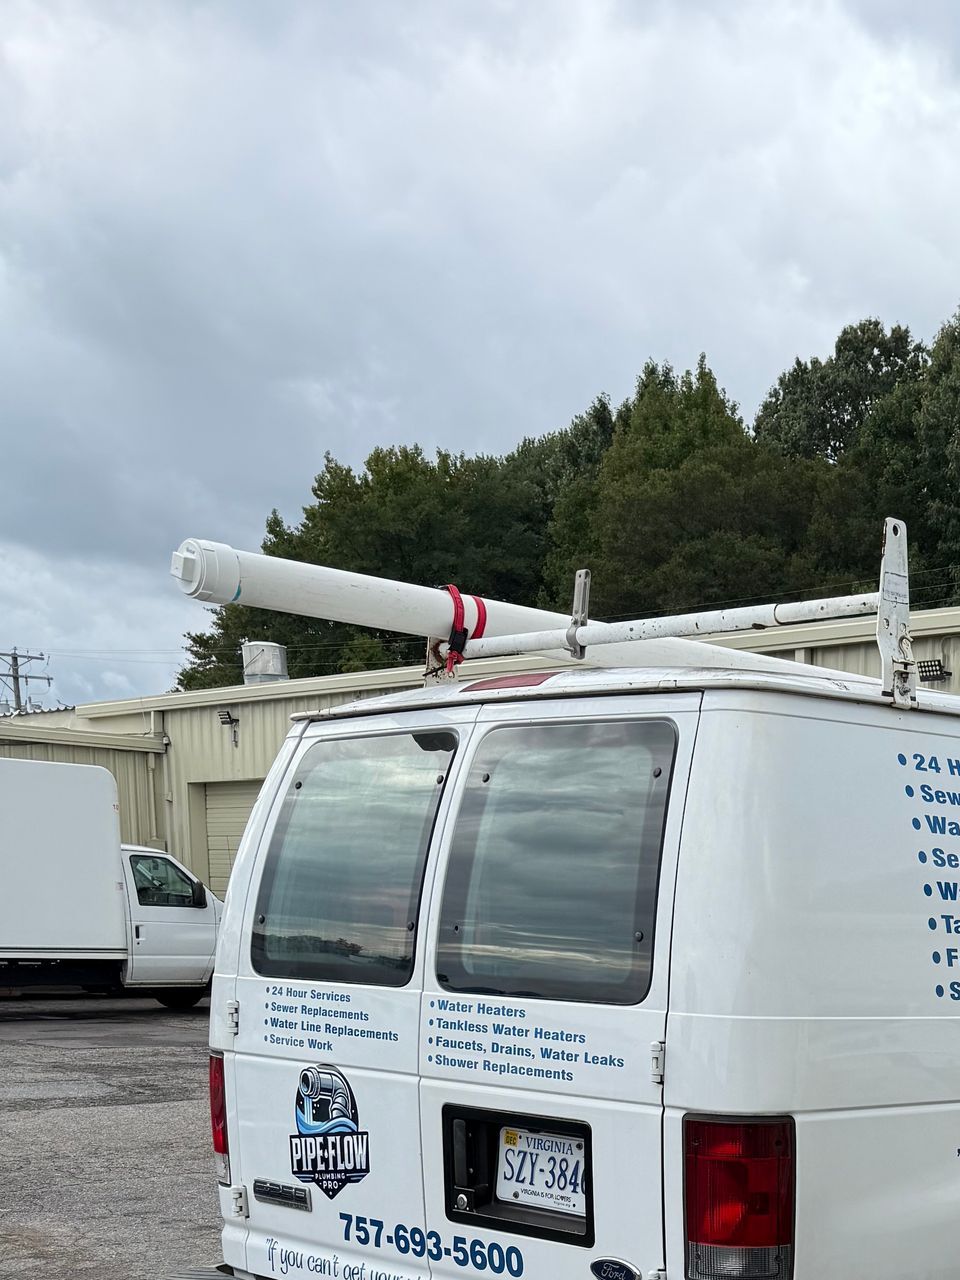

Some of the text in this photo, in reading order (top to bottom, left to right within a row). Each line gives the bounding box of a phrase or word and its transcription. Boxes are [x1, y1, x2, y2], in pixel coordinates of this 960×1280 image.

[913, 753, 941, 774] 24
[272, 986, 351, 1002] 24 Hour Services
[271, 1002, 369, 1021] Sewer Replacements
[437, 1000, 526, 1018] Water Heaters
[270, 1018, 399, 1042] Water Line Replacements
[436, 1018, 586, 1044] Tankless Water Heaters
[270, 1034, 333, 1052] Service Work
[436, 1036, 625, 1068] Faucets, Drains, Water Leaks
[434, 1054, 574, 1082] Shower Replacements
[526, 1136, 574, 1155] VIRGINIA
[314, 1172, 346, 1180] PLUMBING
[339, 1212, 524, 1278] 757-693-5600
[280, 1248, 304, 1274] you
[308, 1254, 339, 1278] can't
[601, 1262, 626, 1280] Ford
